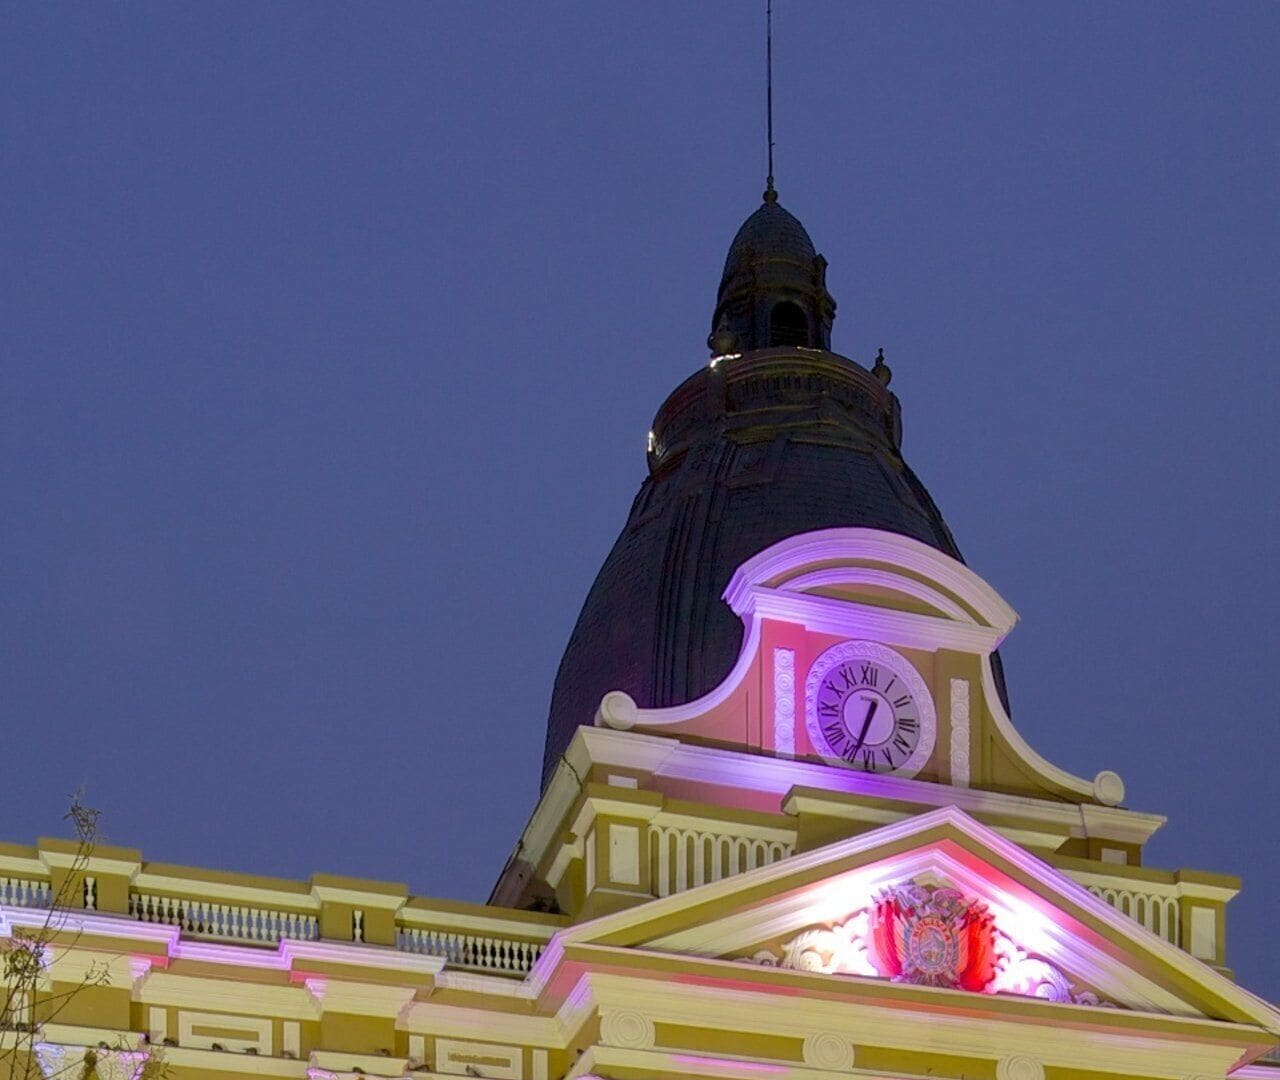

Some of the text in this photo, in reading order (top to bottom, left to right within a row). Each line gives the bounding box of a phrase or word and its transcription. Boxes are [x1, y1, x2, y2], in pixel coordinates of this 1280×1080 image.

[839, 666, 857, 689] XI
[860, 665, 878, 687] XII
[826, 681, 845, 699] X
[820, 700, 839, 717] IX
[898, 718, 916, 733] III
